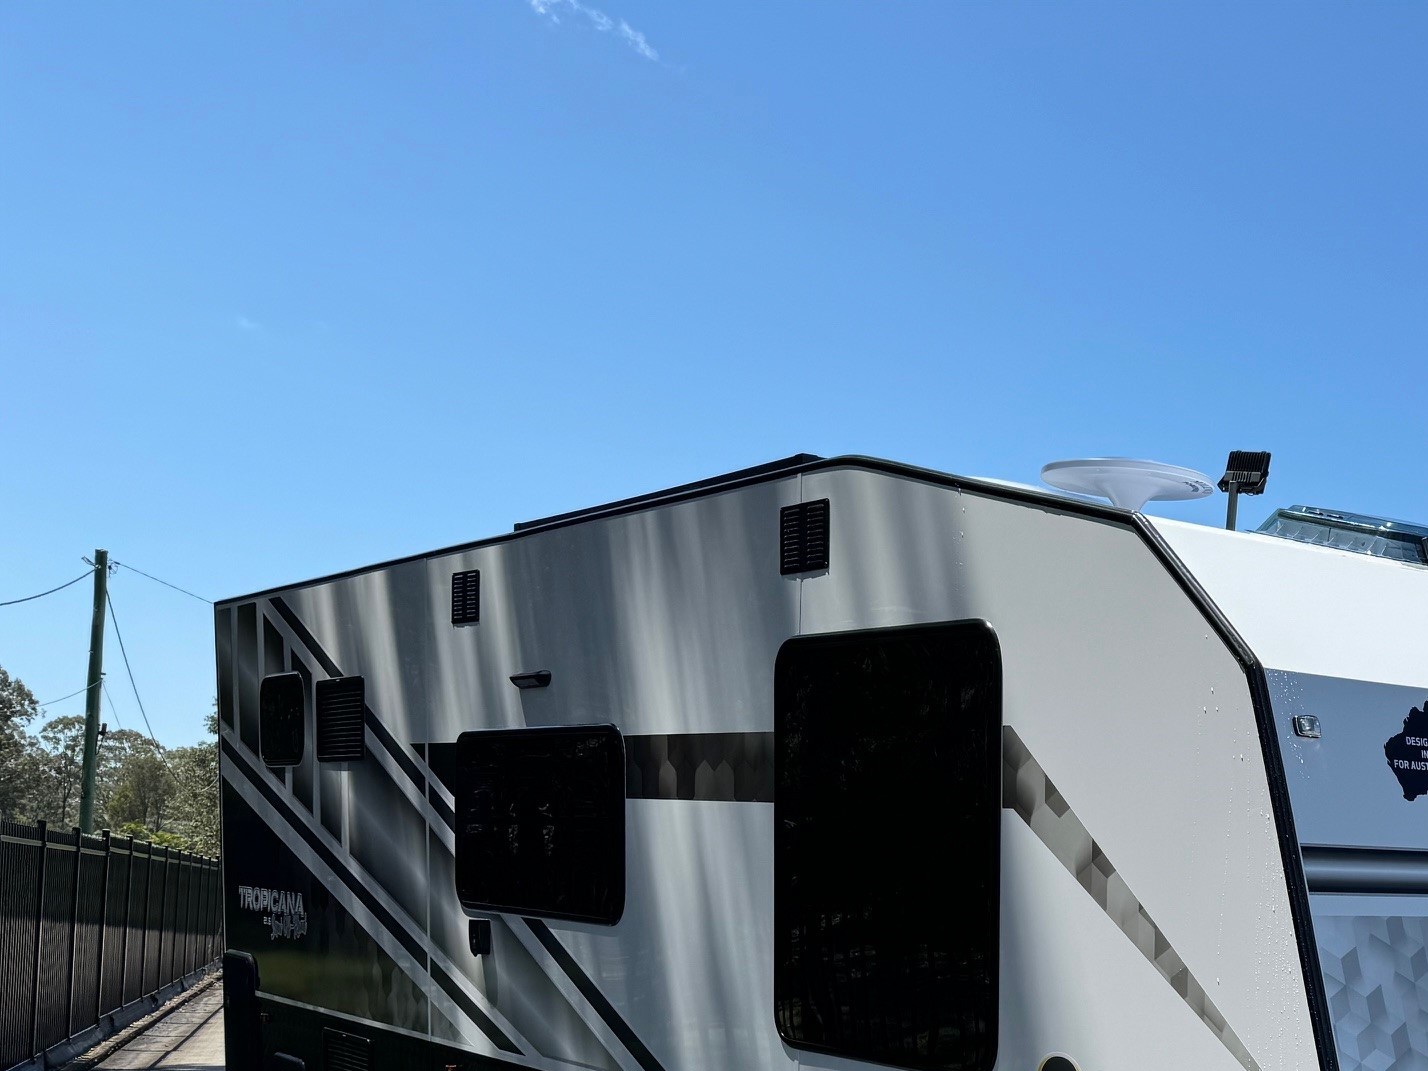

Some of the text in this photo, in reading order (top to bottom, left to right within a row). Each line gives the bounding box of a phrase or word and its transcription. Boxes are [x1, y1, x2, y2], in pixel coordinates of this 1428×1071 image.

[1421, 750, 1428, 759] IN
[1393, 759, 1410, 769] FOR
[239, 885, 305, 917] TROPICANA
